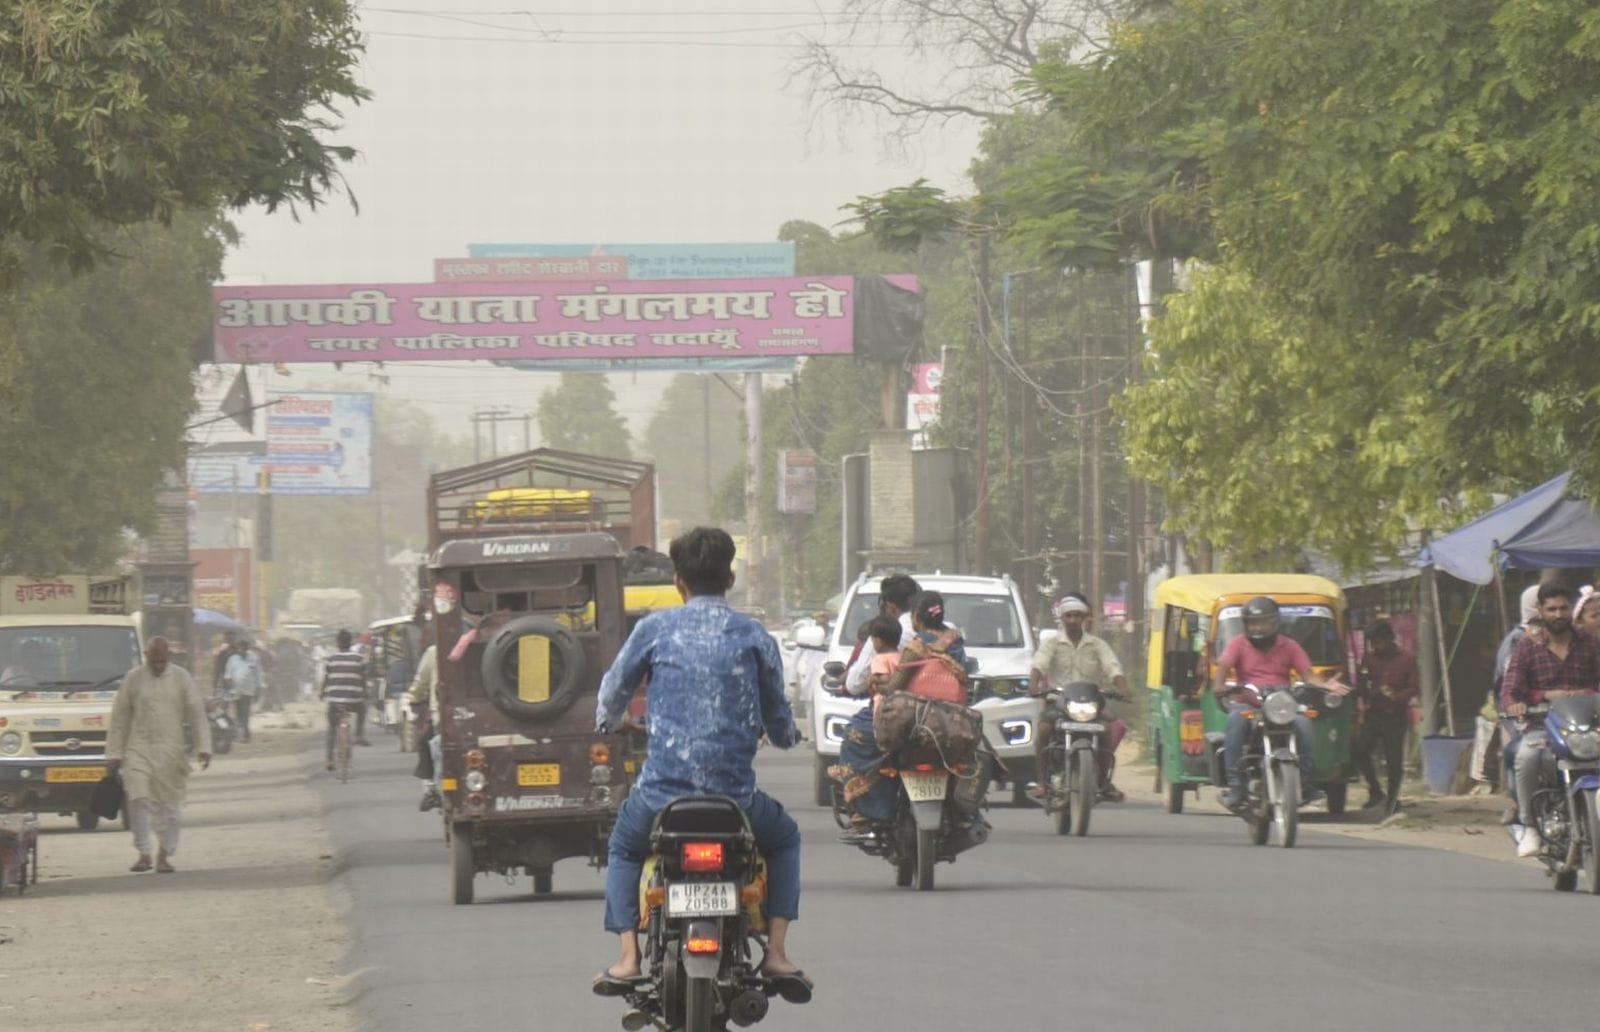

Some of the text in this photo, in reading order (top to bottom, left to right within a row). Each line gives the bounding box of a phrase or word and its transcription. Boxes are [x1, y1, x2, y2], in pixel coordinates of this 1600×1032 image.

[218, 290, 397, 327] आपकी
[556, 285, 774, 321] मंगलमय
[790, 283, 846, 318] हो
[308, 337, 381, 350] नगर
[392, 333, 522, 349] पालिका
[912, 786, 941, 798] 7810
[684, 885, 727, 897] UP24A
